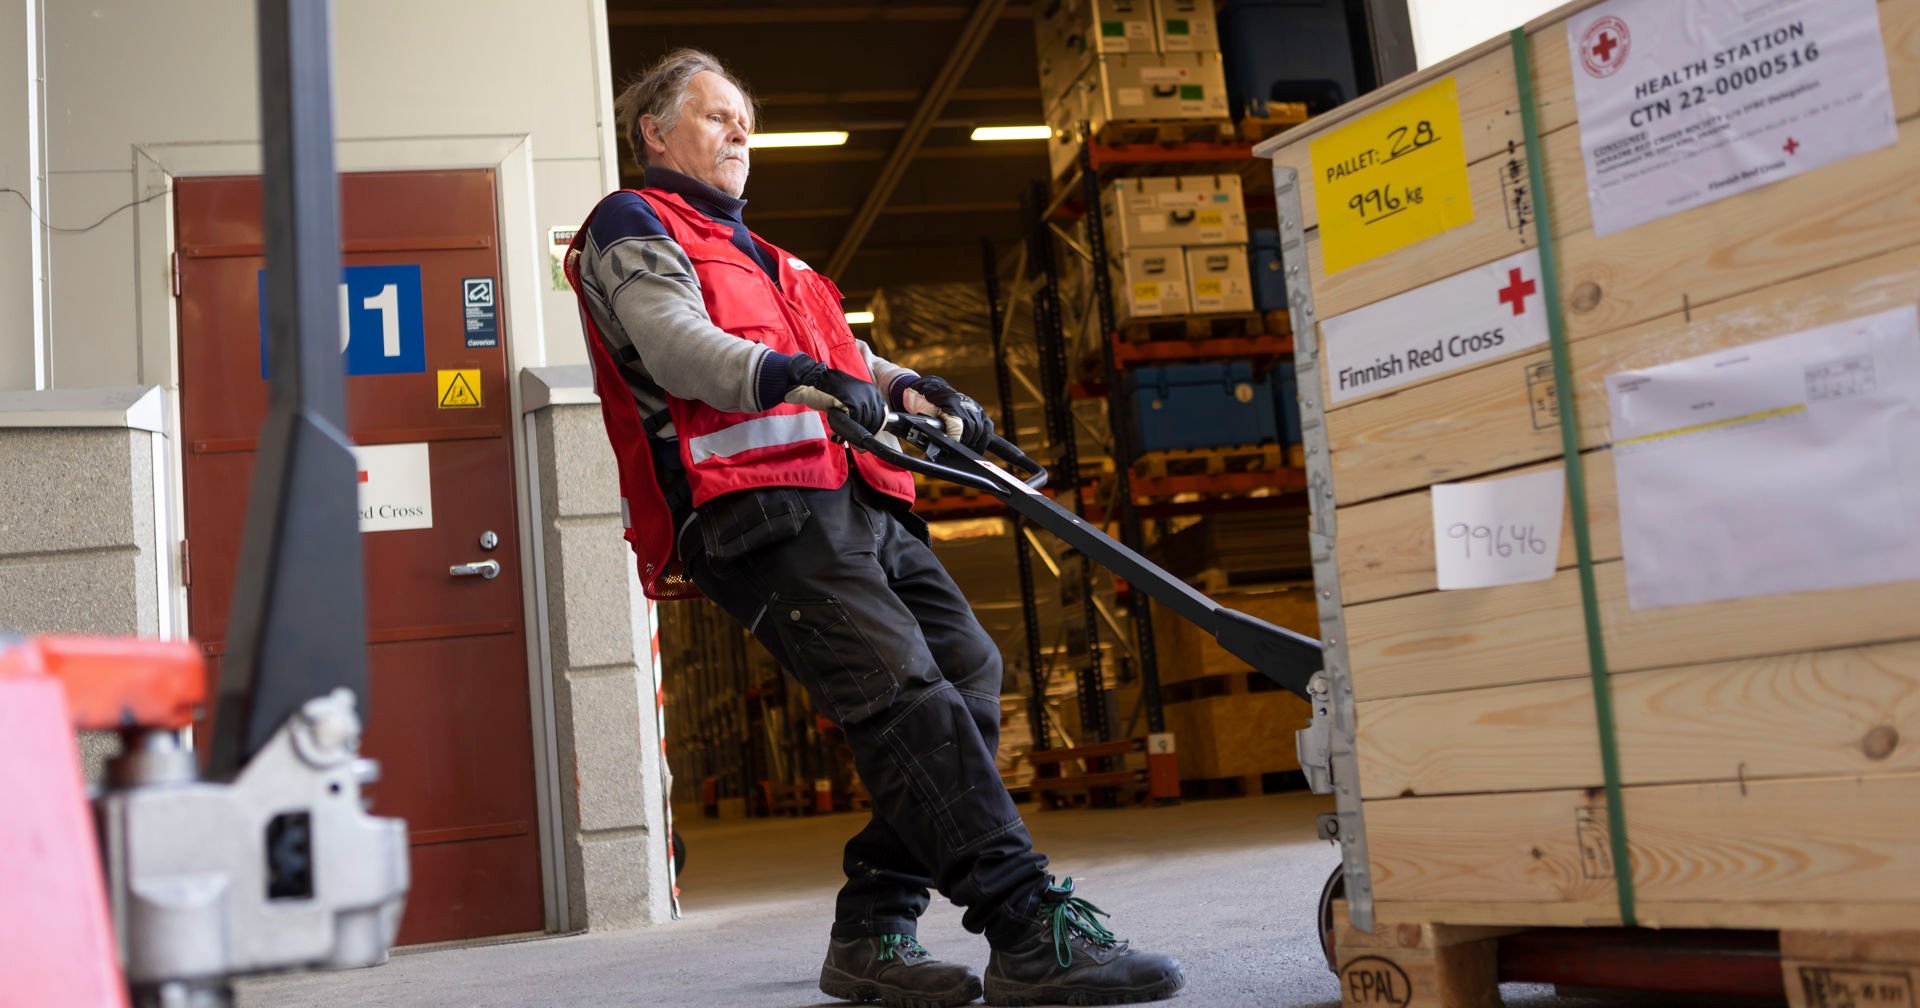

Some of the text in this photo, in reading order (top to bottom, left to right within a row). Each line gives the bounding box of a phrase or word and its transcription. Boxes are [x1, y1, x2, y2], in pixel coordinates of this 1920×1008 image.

[1635, 21, 1804, 99] HEALTH STATION
[1630, 99, 1672, 127] CTN
[1680, 41, 1819, 111] 22-0000516
[1326, 121, 1434, 184] PALLET: 28
[1708, 161, 1785, 191] Finnish Red Cross
[1348, 184, 1424, 218] 996 kg
[1339, 328, 1504, 391] Finnish Red Cross
[356, 504, 424, 520] ed Cross
[1447, 523, 1547, 559] 99646
[1348, 969, 1403, 1005] EPAL
